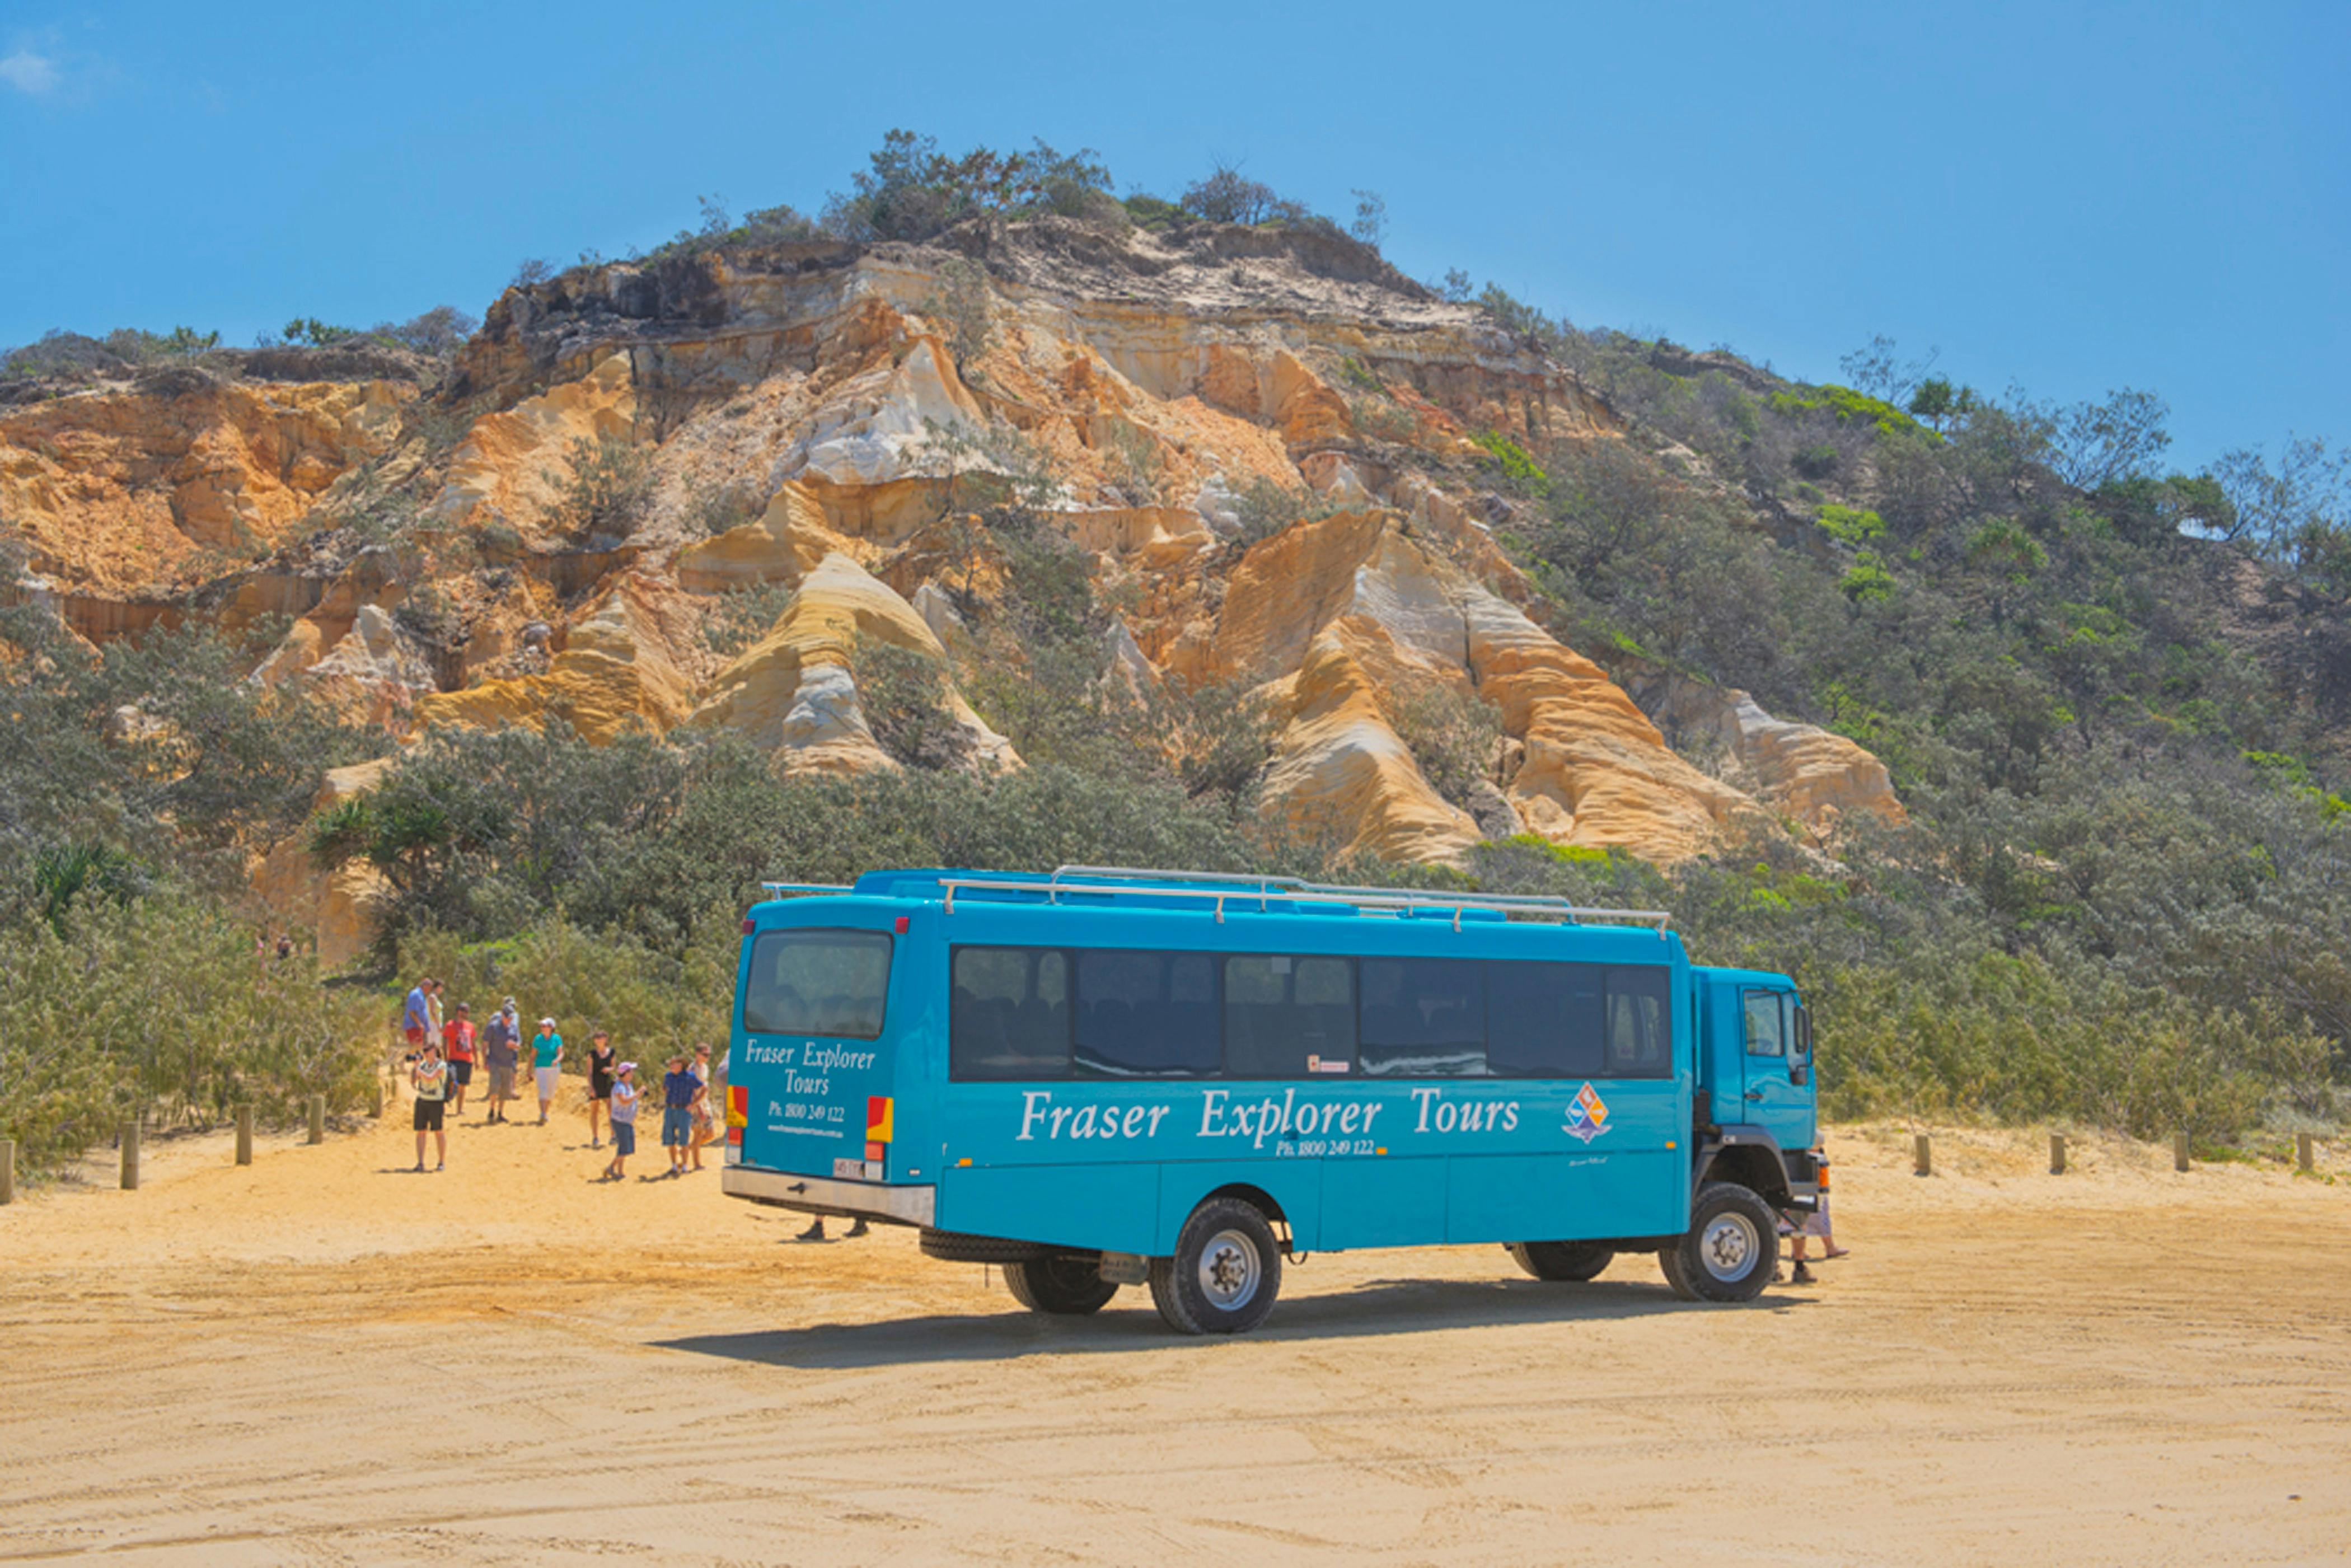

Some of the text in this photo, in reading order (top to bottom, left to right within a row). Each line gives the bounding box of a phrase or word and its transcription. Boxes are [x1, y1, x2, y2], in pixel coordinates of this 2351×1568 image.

[746, 1038, 875, 1074] Fraser Explorer
[785, 1068, 829, 1096] Tours
[827, 1107, 845, 1122] 122
[1015, 1088, 1520, 1149] Fraser Explorer Tours
[1298, 1140, 1327, 1156] 1800
[1328, 1140, 1351, 1155] 249
[1353, 1139, 1374, 1155] 122
